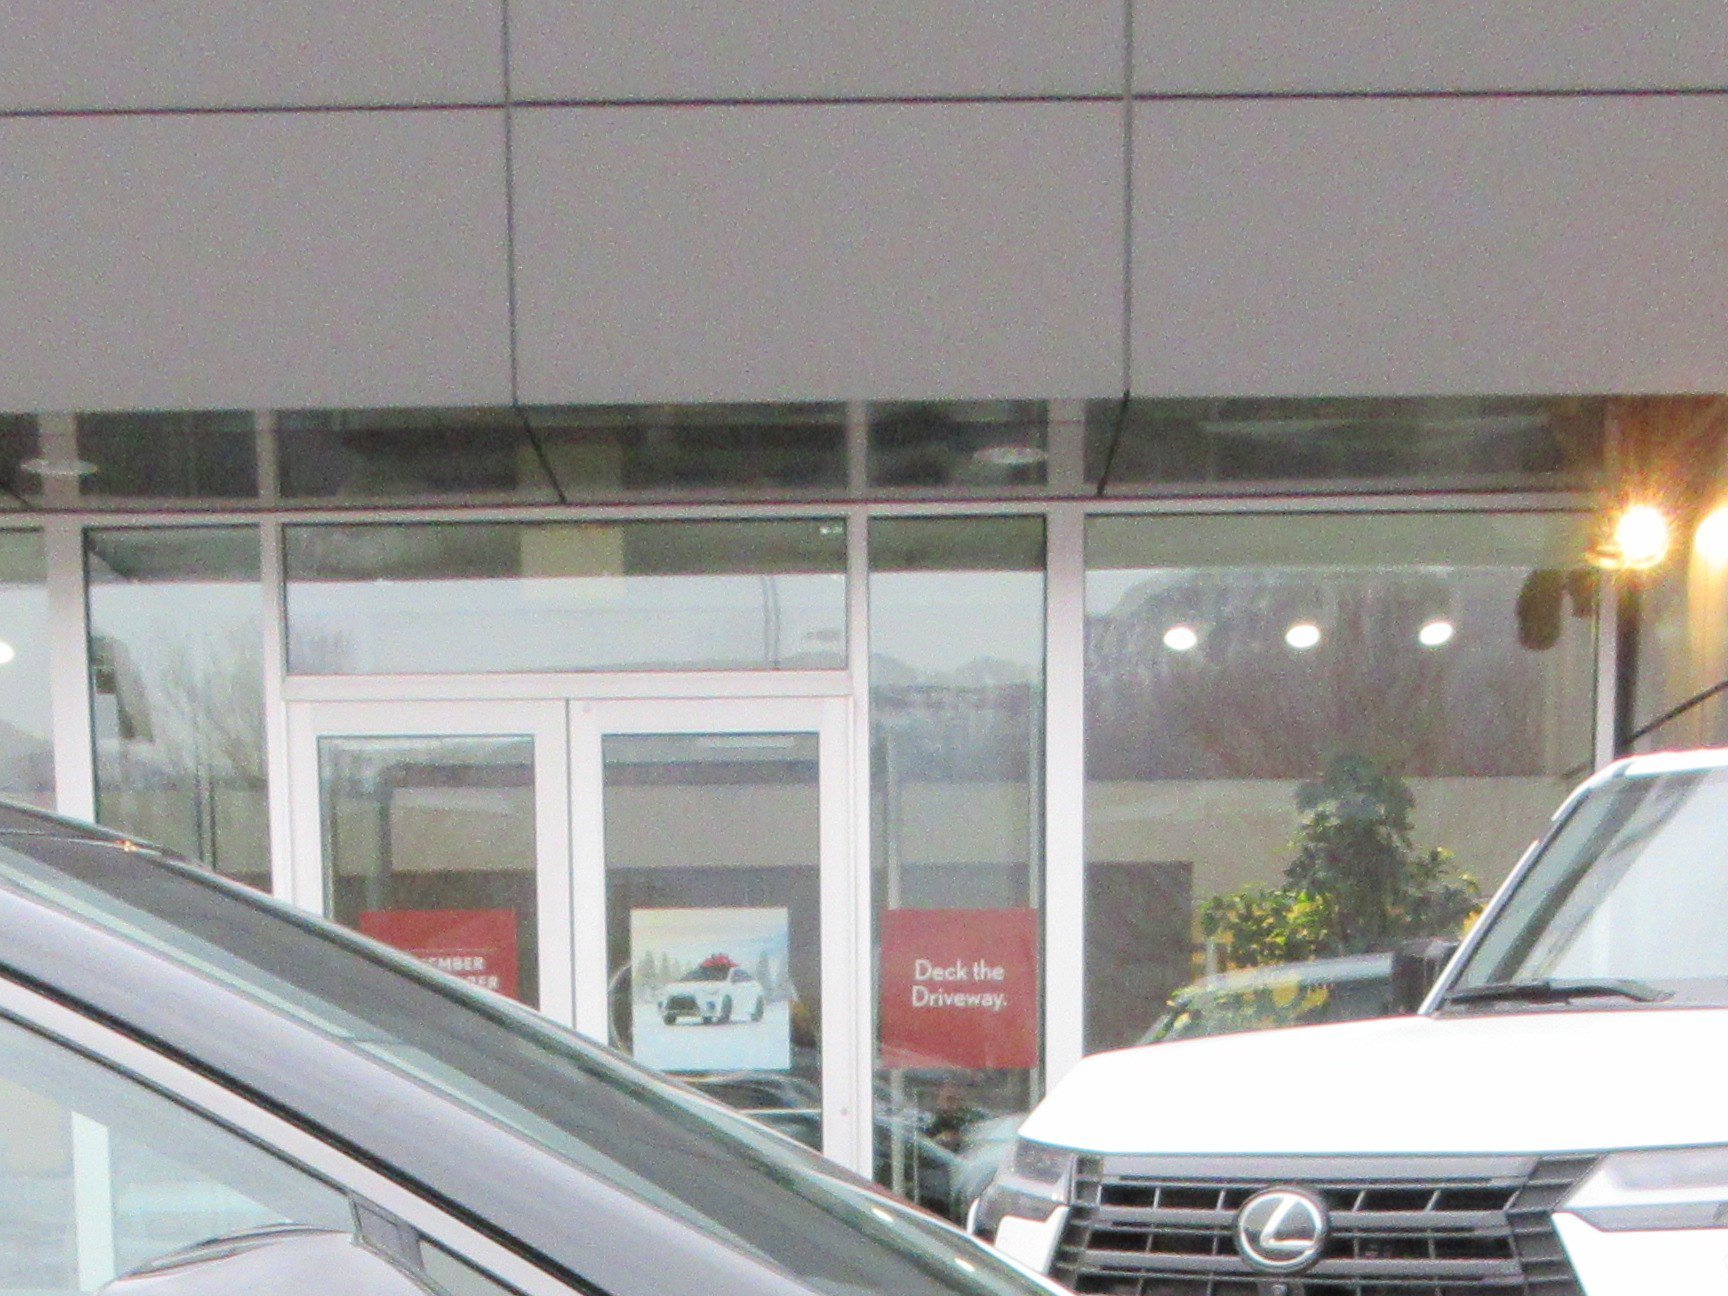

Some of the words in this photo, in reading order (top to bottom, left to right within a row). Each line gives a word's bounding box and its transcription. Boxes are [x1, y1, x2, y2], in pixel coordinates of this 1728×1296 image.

[422, 956, 486, 972] EMBER
[915, 958, 968, 981] Deck
[973, 958, 1005, 981] the
[912, 985, 1008, 1012] Driveway.
